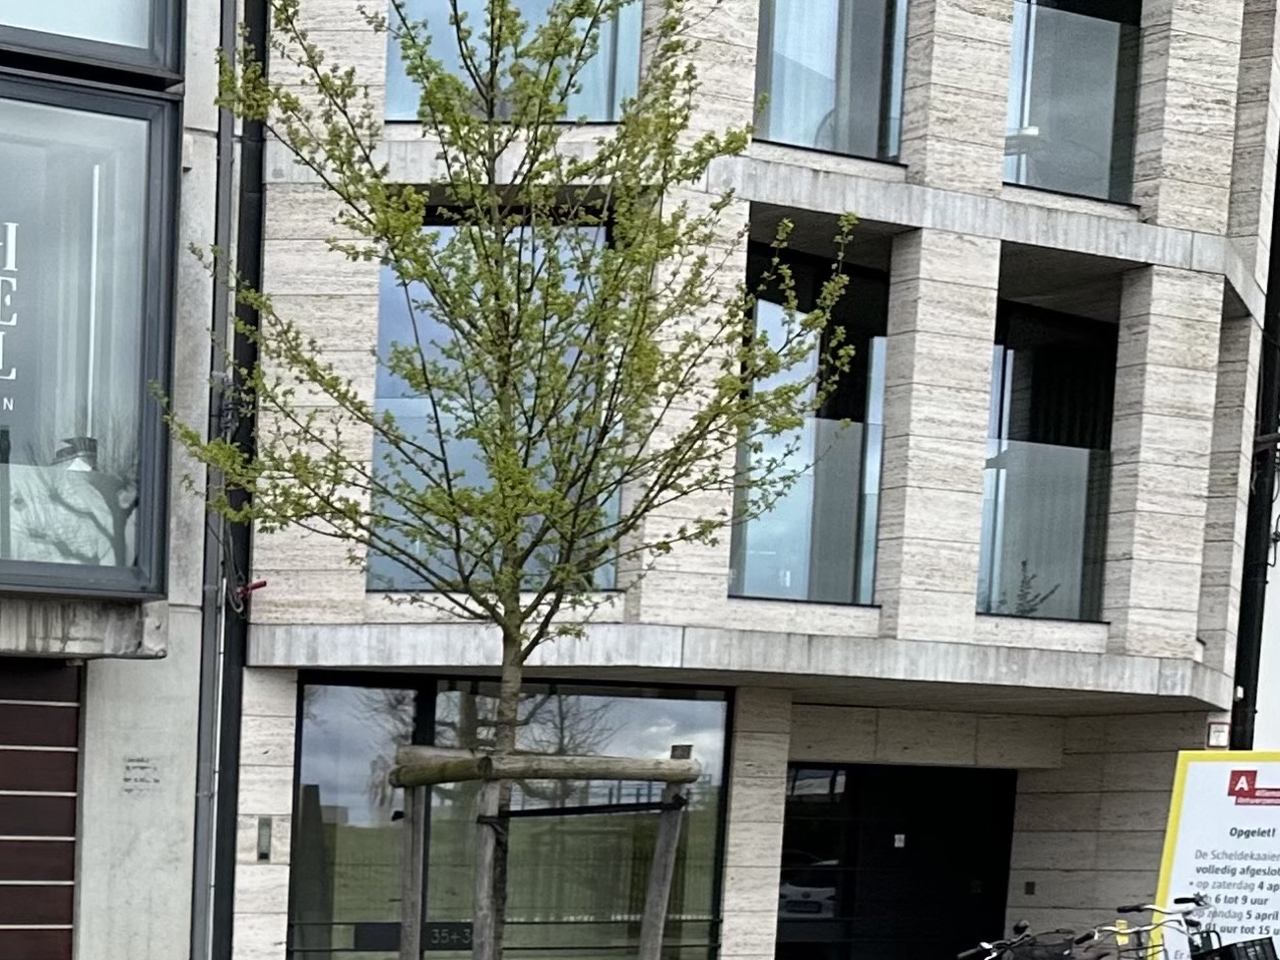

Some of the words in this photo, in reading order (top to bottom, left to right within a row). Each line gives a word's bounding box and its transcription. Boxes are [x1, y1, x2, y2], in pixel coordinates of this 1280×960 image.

[1229, 827, 1276, 839] Opgelet!
[1195, 849, 1208, 860] De
[1196, 864, 1237, 877] volledig
[1196, 881, 1209, 890] op
[1212, 880, 1255, 893] zaterdag
[1257, 881, 1264, 890] 4
[1215, 894, 1221, 904] 6
[1224, 895, 1239, 904] tot
[1241, 895, 1248, 905] 9
[1250, 897, 1269, 905] uur
[1246, 910, 1252, 919] 5
[1254, 910, 1279, 922] april
[1240, 925, 1255, 935] tot
[1258, 926, 1270, 935] 15
